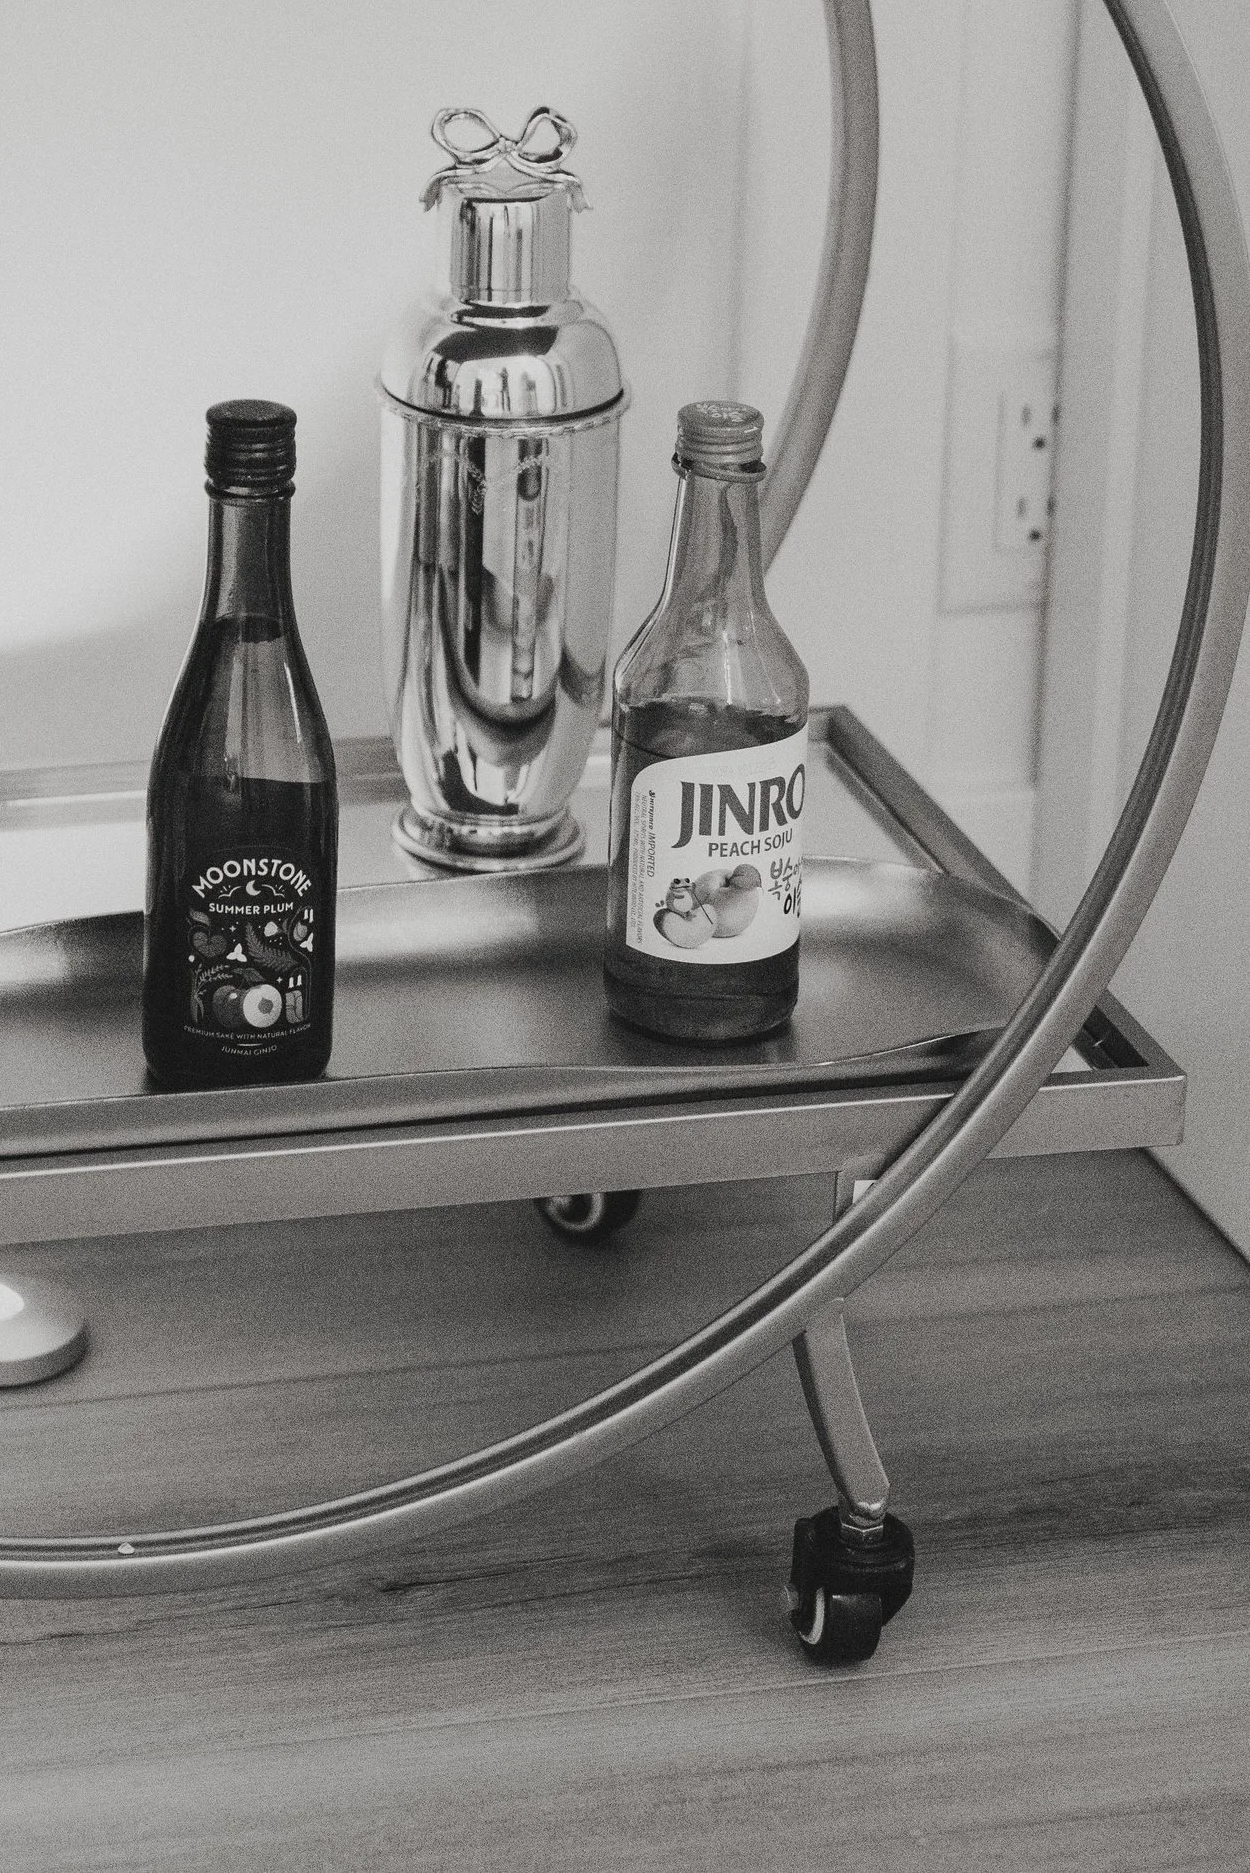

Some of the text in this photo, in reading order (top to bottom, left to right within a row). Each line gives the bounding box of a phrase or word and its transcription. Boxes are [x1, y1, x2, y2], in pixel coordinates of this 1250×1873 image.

[671, 763, 806, 849] JINRO
[646, 832, 656, 878] IMPORTED
[708, 827, 793, 858] PEACH SOJU
[191, 858, 312, 899] MOONSTONE
[209, 902, 294, 915] SUMMER PLUM
[183, 1025, 215, 1038] PREMIUM
[236, 1032, 256, 1041] WITH
[257, 1029, 288, 1040] NATURAL
[221, 1044, 278, 1057] JUNMAI GINJO
